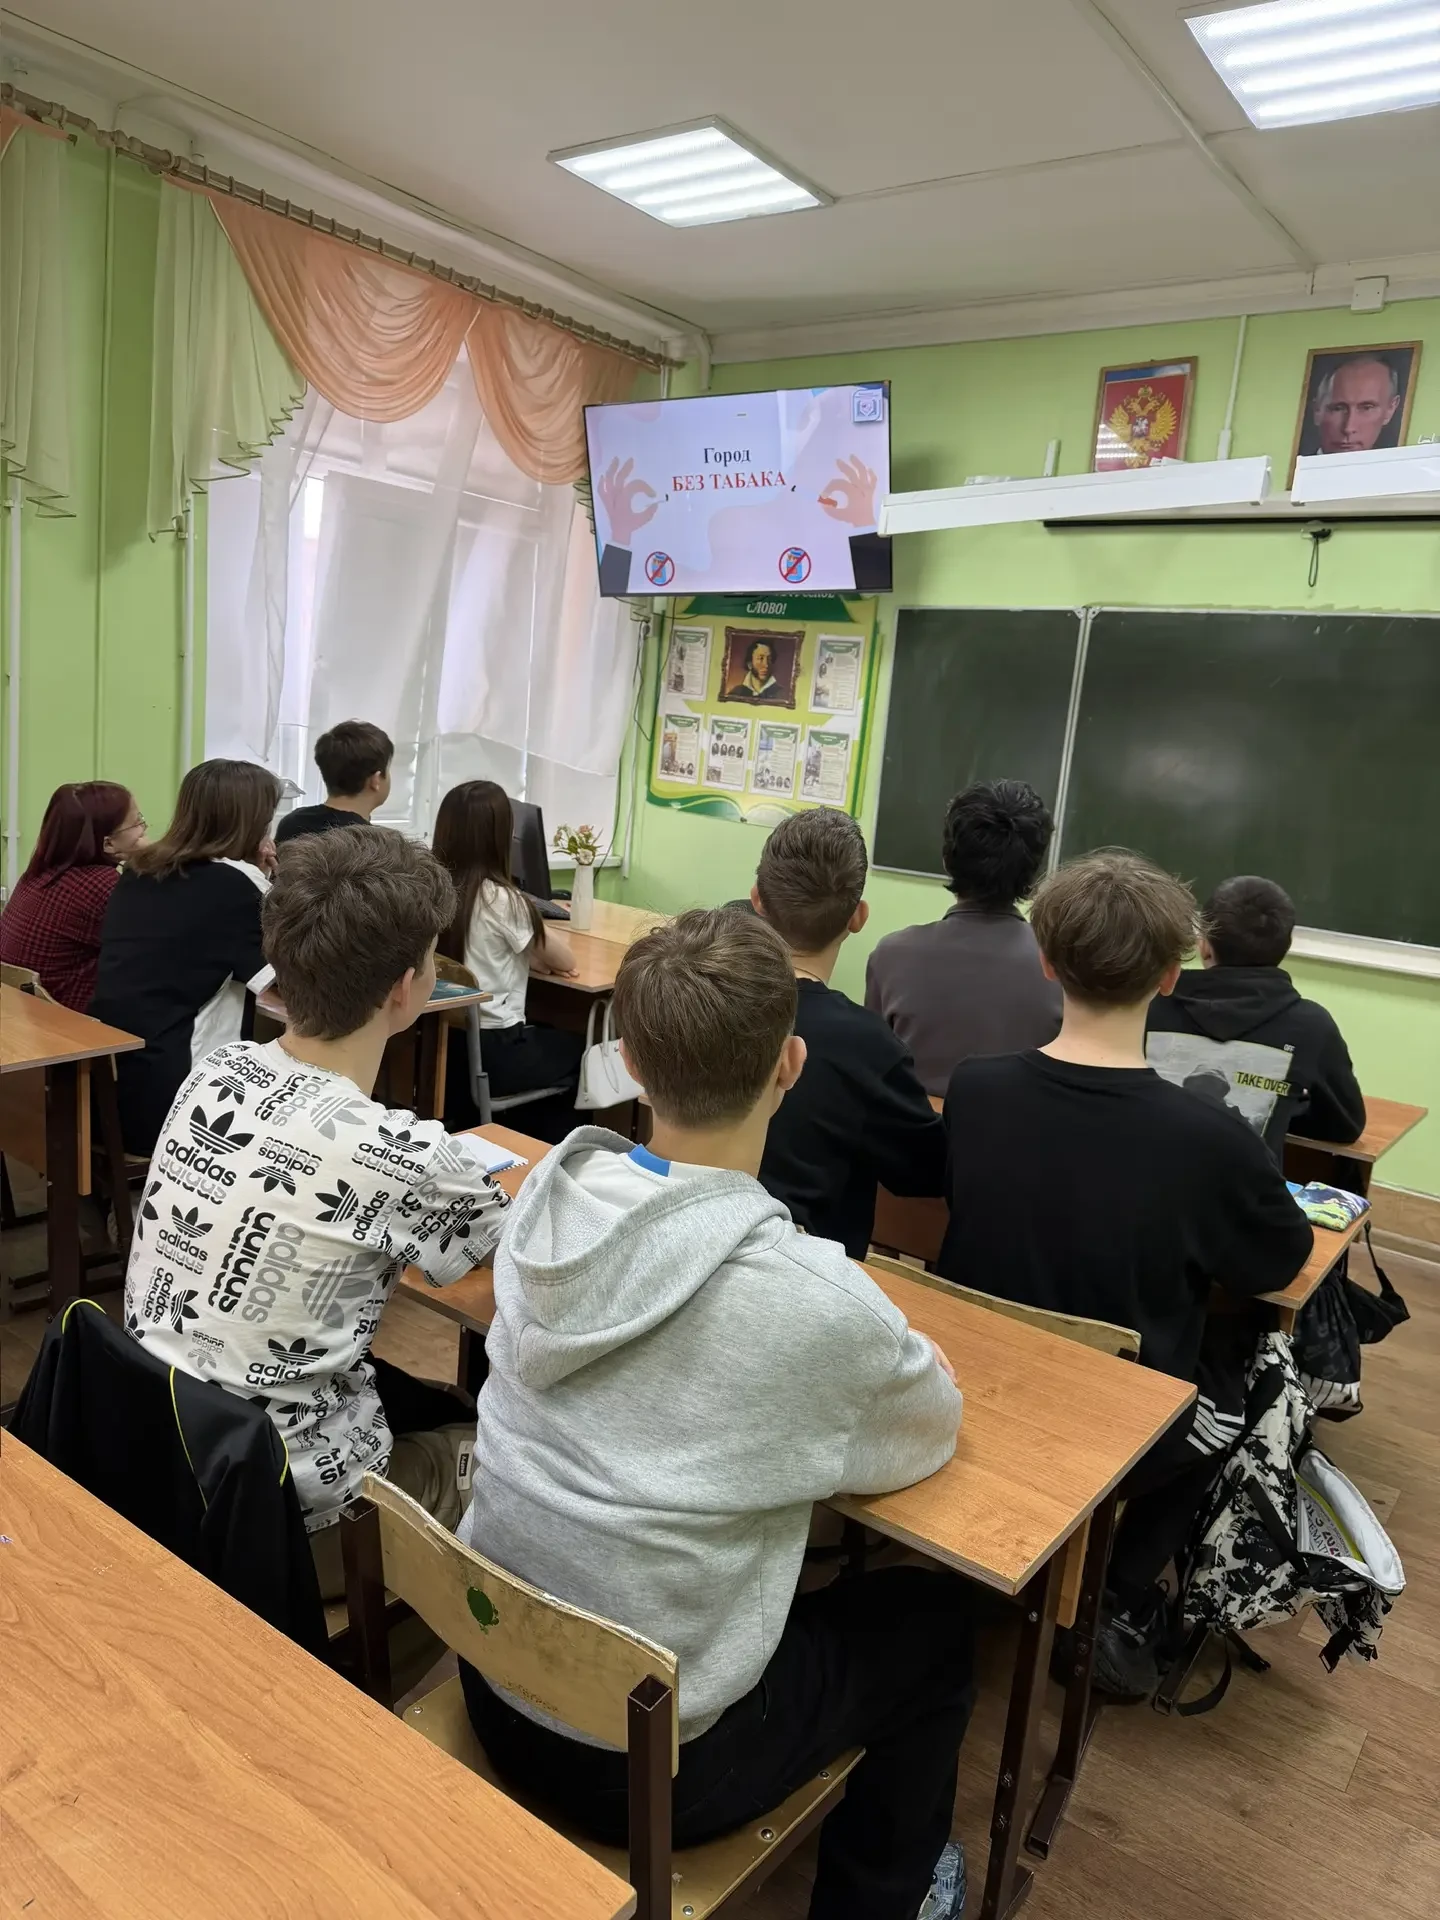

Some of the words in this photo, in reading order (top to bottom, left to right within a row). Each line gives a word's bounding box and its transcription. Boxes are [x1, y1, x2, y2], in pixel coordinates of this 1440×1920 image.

[703, 447, 751, 467] Город
[672, 474, 705, 492] БЕЗ
[709, 469, 787, 490] ТАБАКА
[746, 601, 788, 615] СЛОВО!
[224, 1058, 272, 1089] adidas
[1236, 1071, 1263, 1089] TAKE
[1263, 1078, 1289, 1095] OVER
[165, 1138, 237, 1187] adidas
[258, 1146, 316, 1176] adidas
[358, 1142, 426, 1174] adidas
[352, 1190, 390, 1241] adidas
[158, 1228, 208, 1262] adidas
[241, 1222, 306, 1323] adidas
[152, 1272, 174, 1324] adidas
[191, 1337, 223, 1354] adidas
